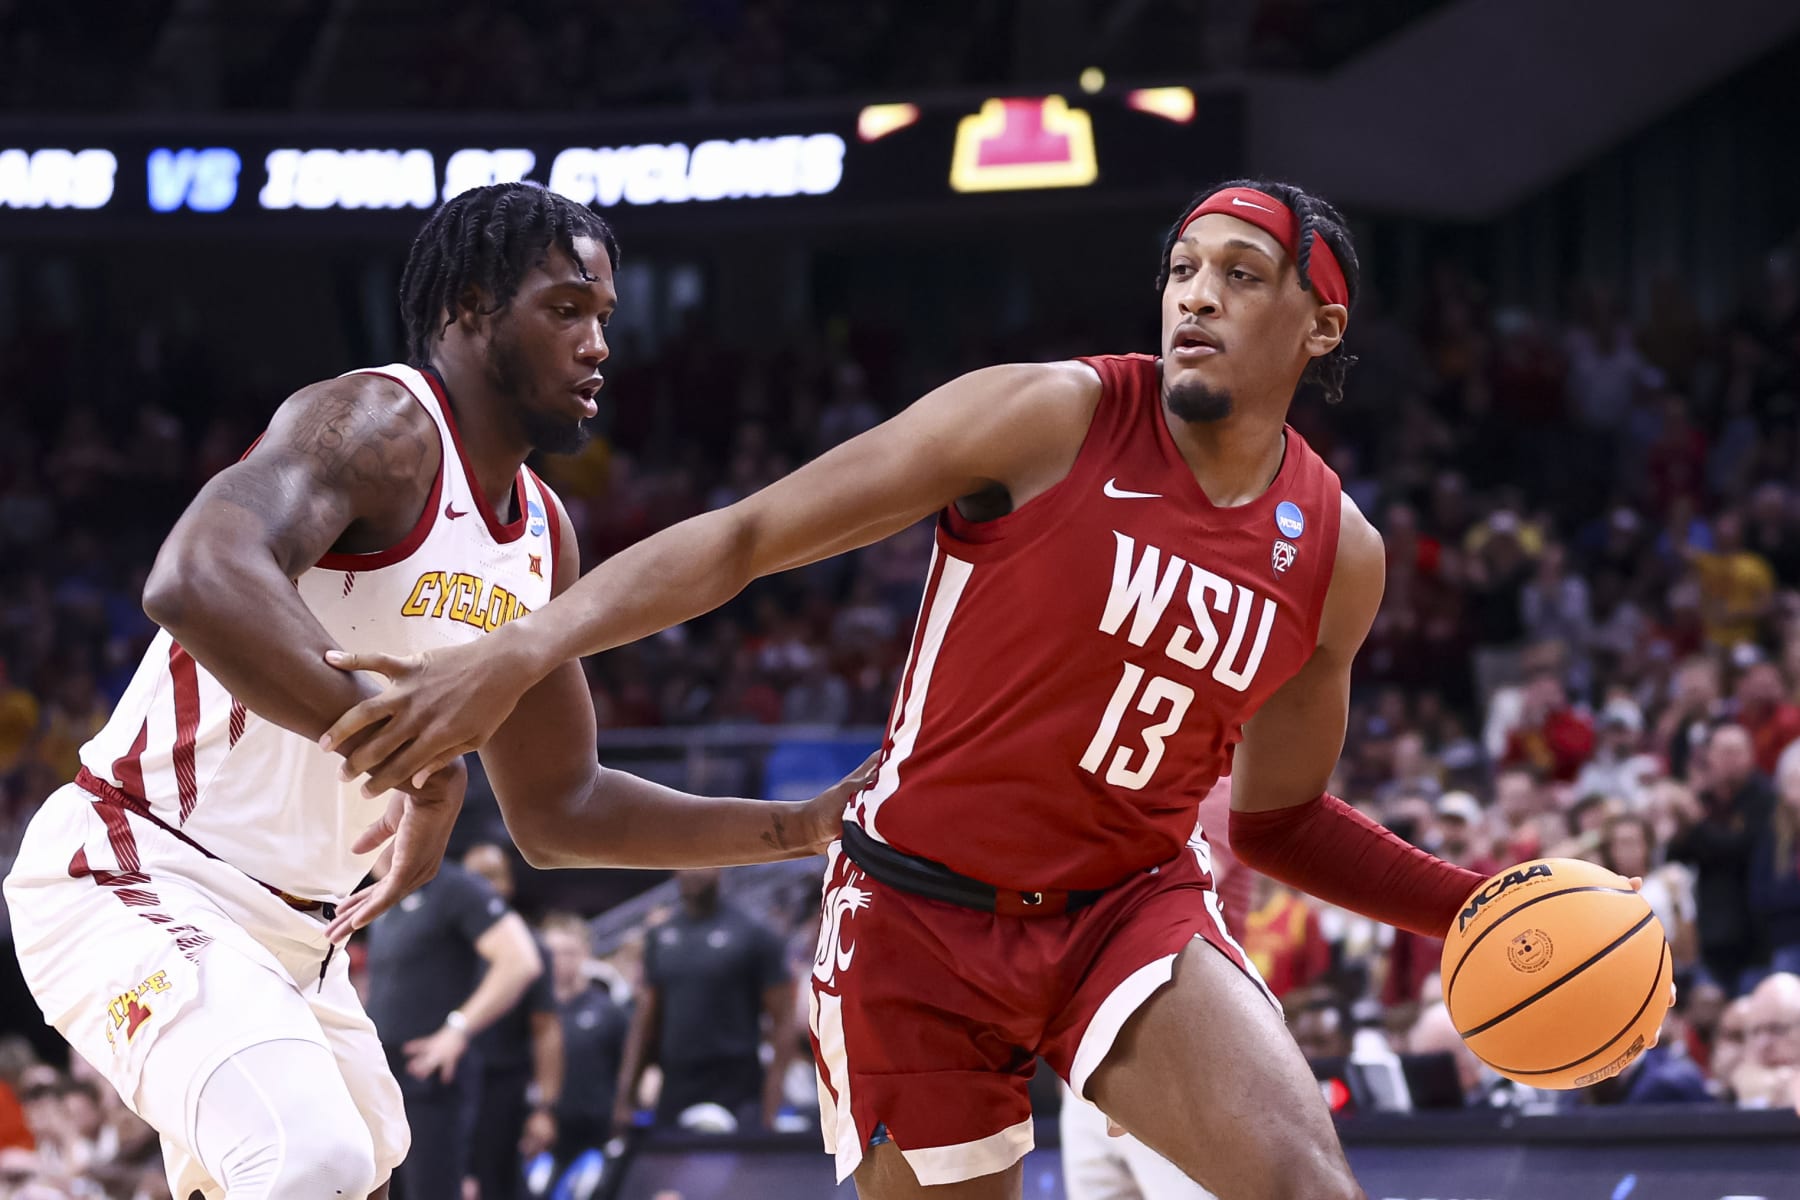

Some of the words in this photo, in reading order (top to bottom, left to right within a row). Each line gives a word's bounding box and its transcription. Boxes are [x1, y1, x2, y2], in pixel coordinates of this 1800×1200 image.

[147, 147, 241, 212] VS
[260, 148, 437, 209] IOWA
[549, 134, 846, 207] CYCLONES
[1273, 541, 1297, 567] PAC
[1274, 556, 1287, 573] 12
[401, 571, 532, 633] CYCLON
[1098, 529, 1277, 692] WSU
[1078, 660, 1195, 790] 13
[1458, 864, 1552, 933] NCAA
